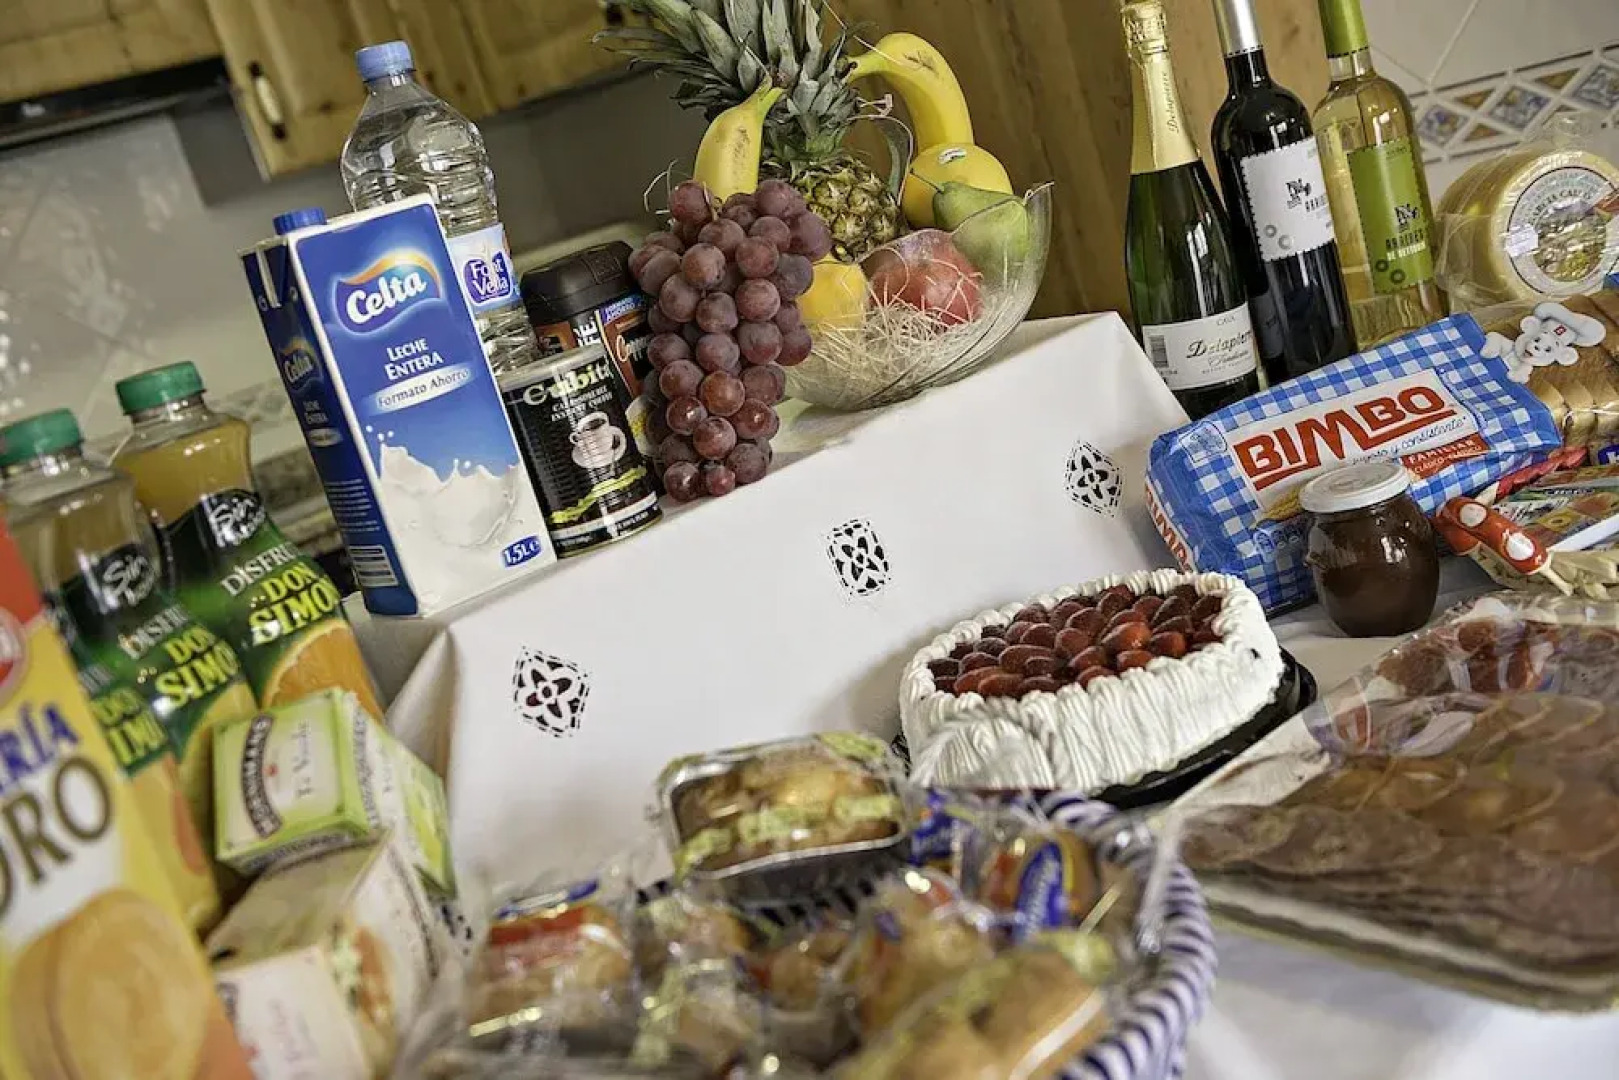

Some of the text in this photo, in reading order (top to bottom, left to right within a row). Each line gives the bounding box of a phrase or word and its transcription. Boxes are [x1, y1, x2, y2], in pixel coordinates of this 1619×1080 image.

[346, 271, 427, 324] Celta
[385, 352, 444, 381] ENTERA
[386, 337, 429, 362] LECHE
[378, 368, 469, 407] Formato Ahorro
[1233, 386, 1447, 481] BIMBO
[1408, 439, 1476, 464] FAMILIAR
[0, 702, 80, 788] RÍA
[0, 755, 112, 920] RO
